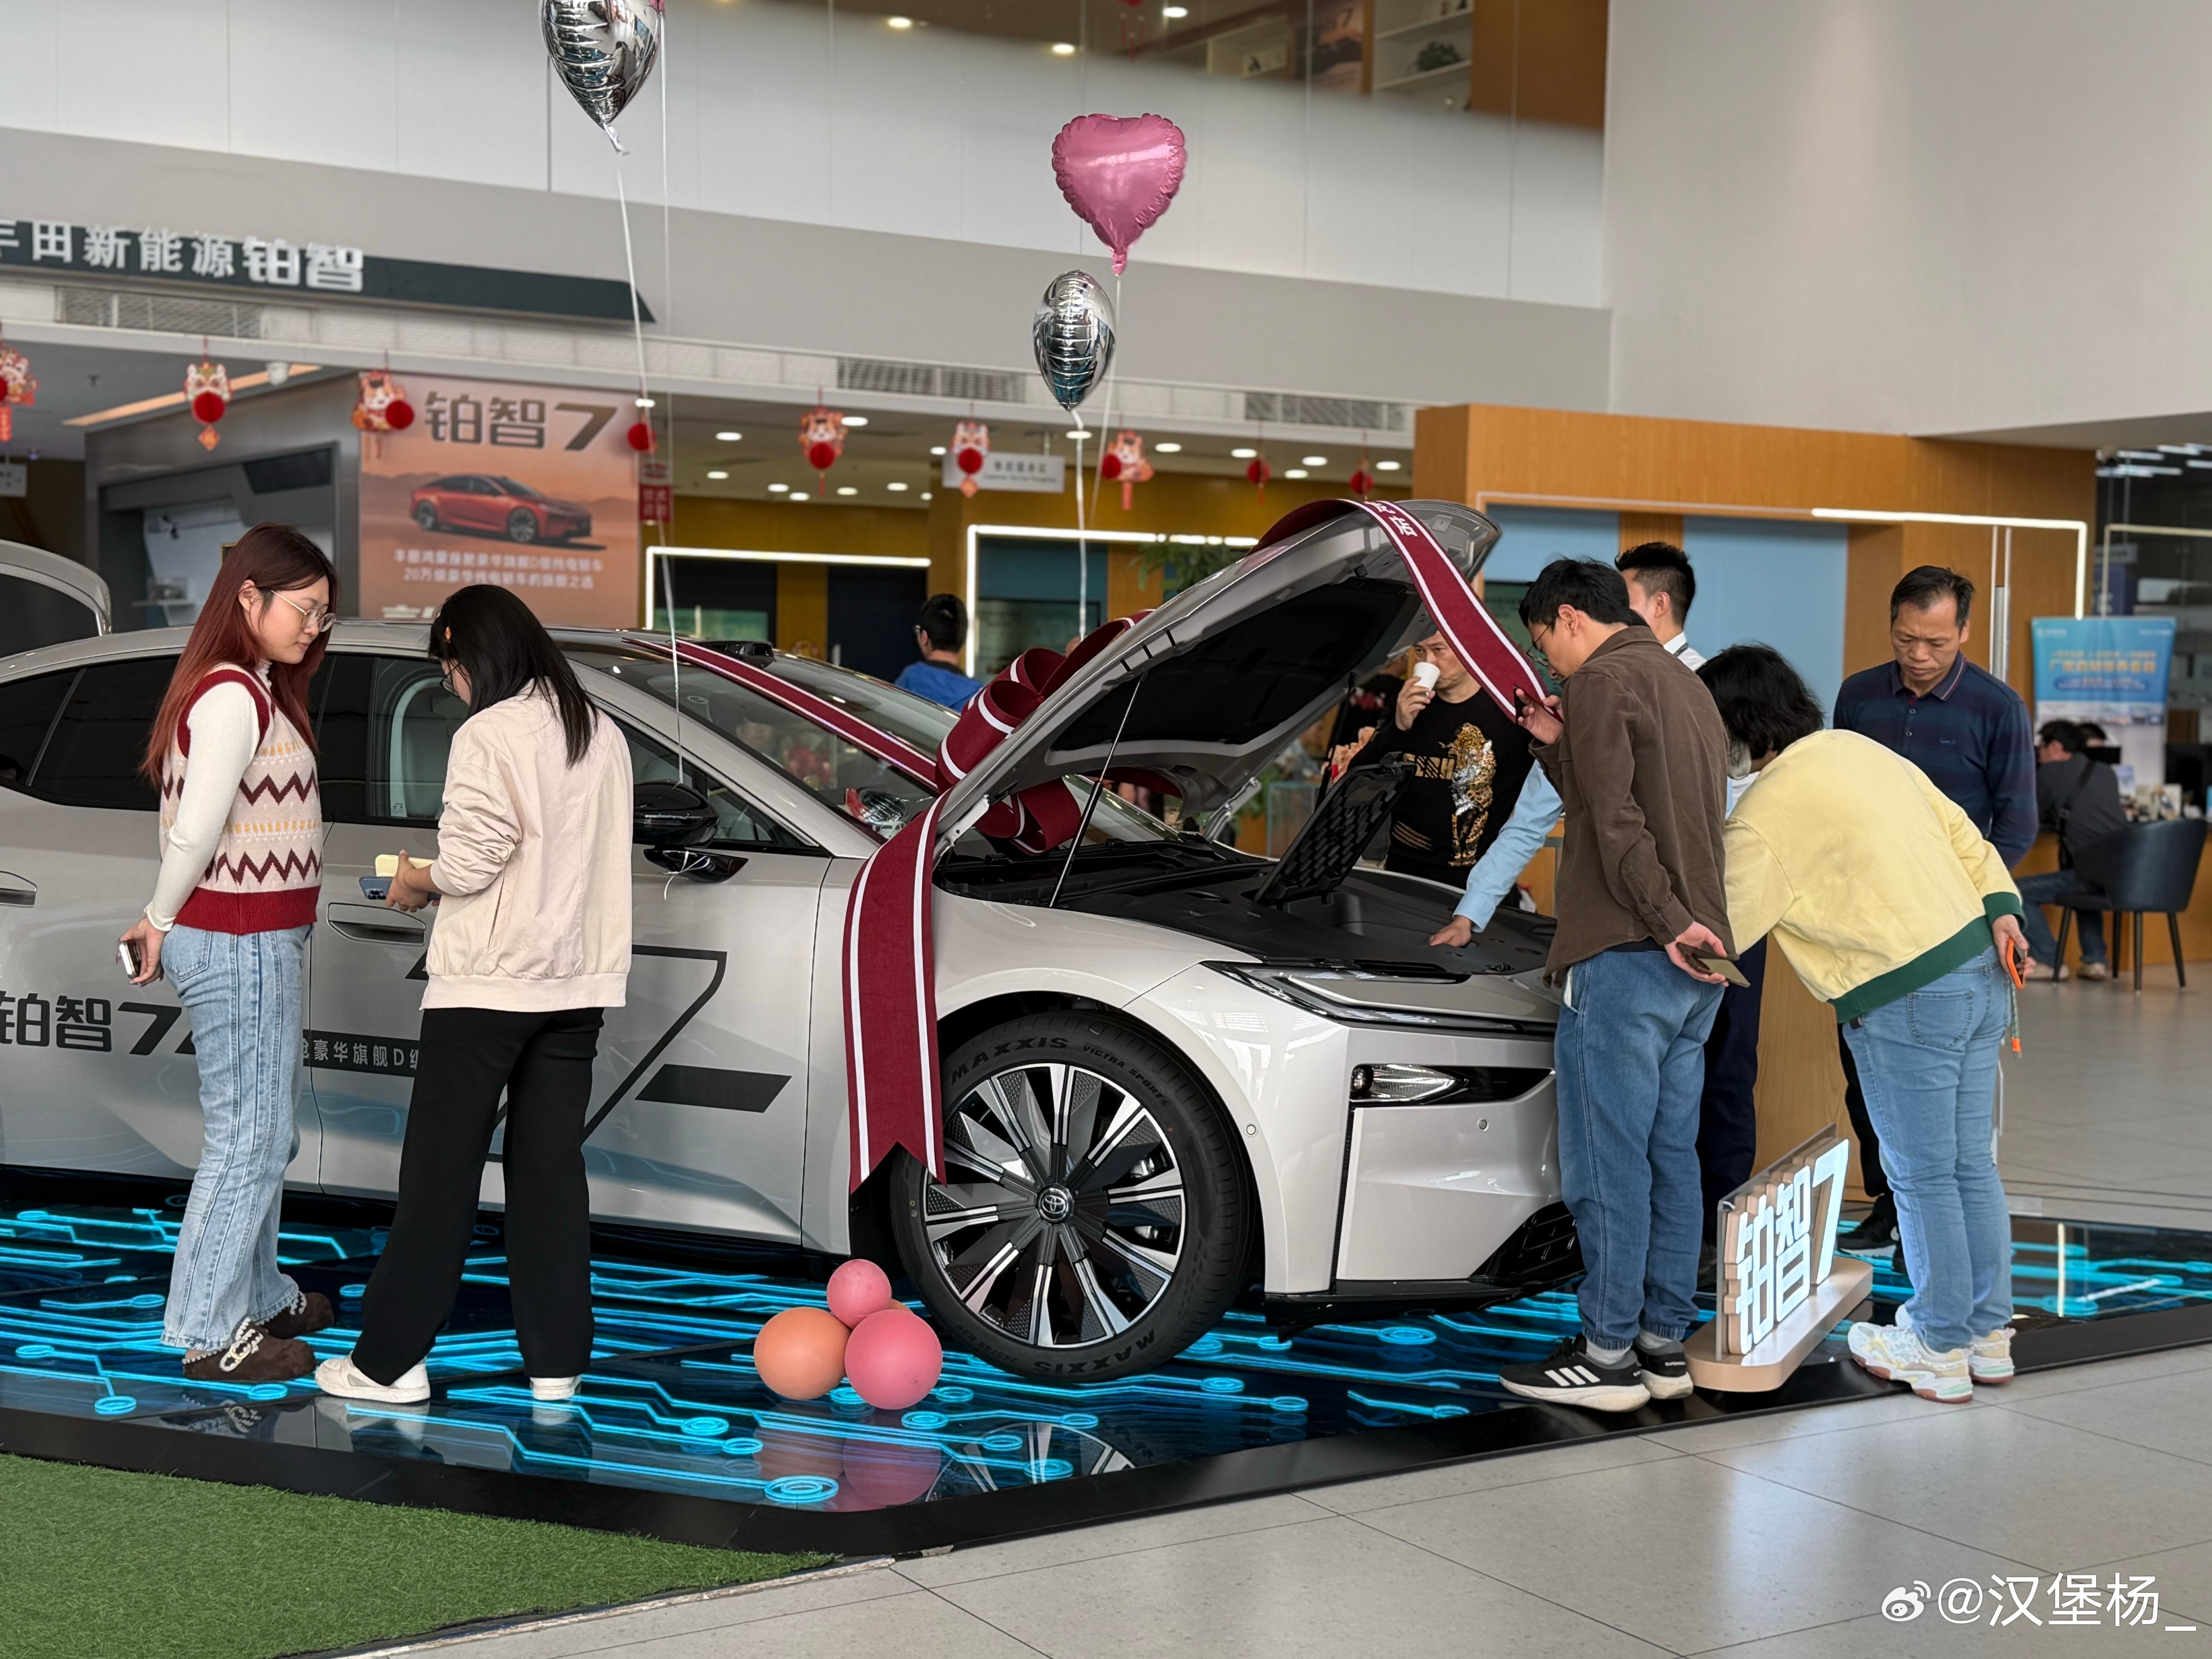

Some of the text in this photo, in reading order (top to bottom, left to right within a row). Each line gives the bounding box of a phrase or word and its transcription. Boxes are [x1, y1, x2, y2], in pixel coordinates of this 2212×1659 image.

[426, 391, 618, 452] 铂智7
[0, 990, 182, 1056] 铂智7
[951, 1037, 1069, 1085] MAXXIS
[1083, 1045, 1125, 1069] VICTRA
[1128, 1068, 1165, 1098] SPORT
[1736, 1139, 1849, 1355] 铂智7
[1033, 1328, 1155, 1374] MAXXIS
